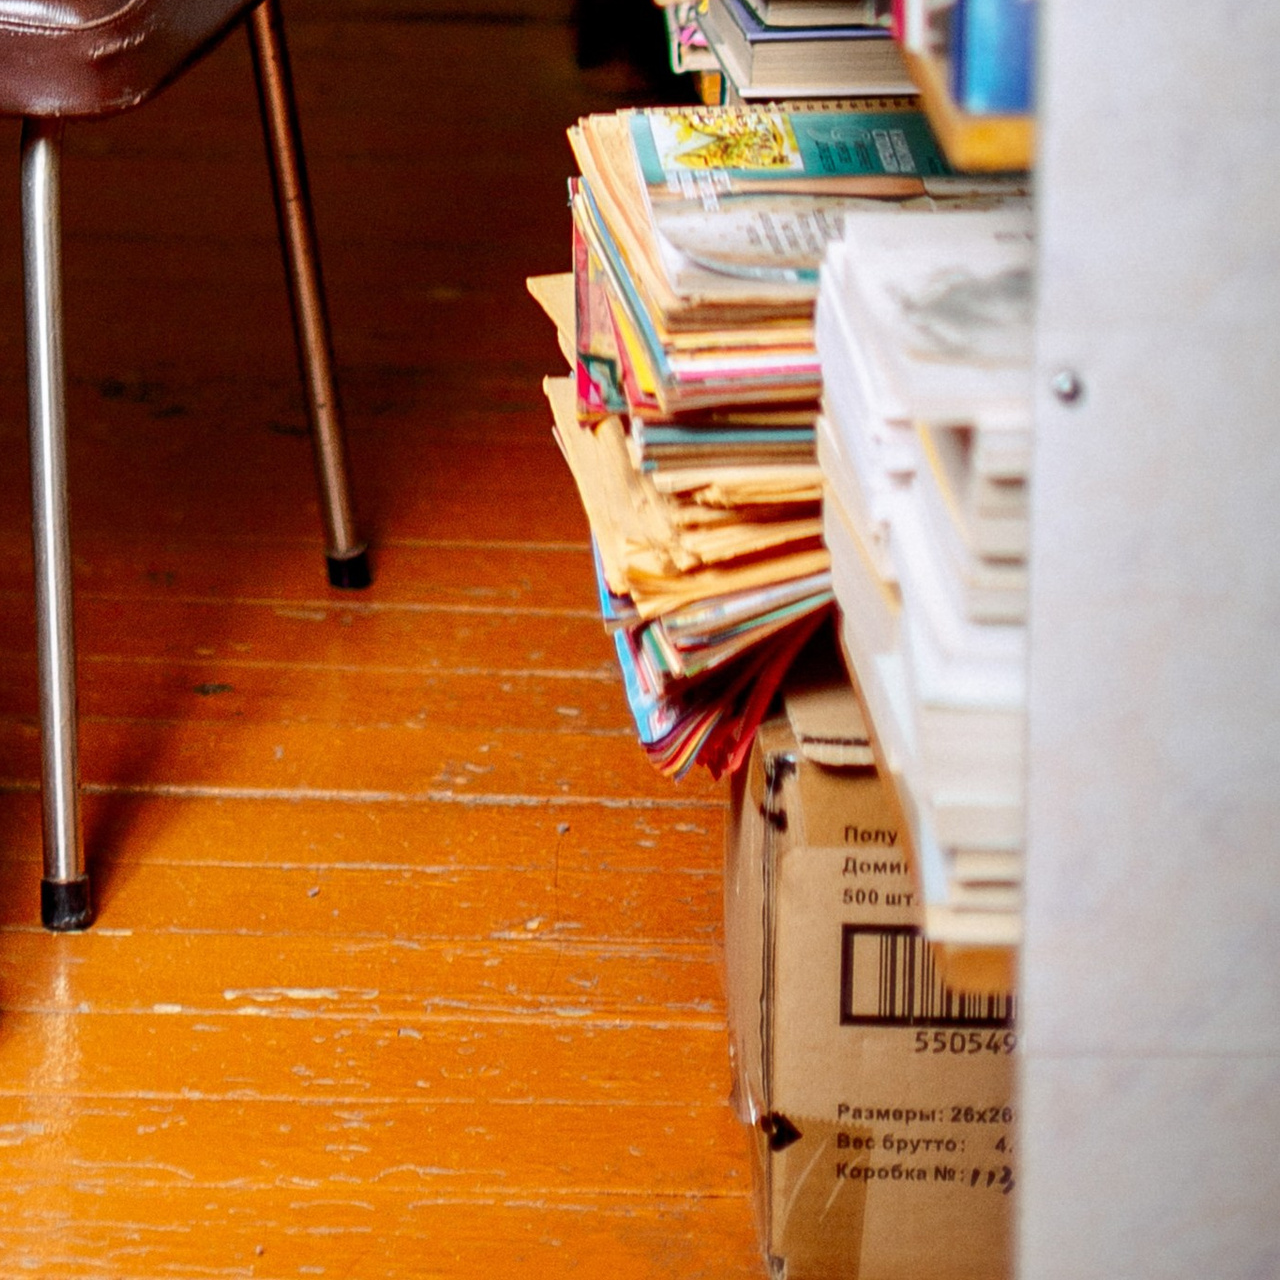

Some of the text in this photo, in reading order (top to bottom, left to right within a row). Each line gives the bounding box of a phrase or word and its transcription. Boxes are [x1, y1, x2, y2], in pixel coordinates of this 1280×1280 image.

[842, 887, 879, 906] 500
[915, 1031, 1017, 1055] 550549
[837, 1103, 944, 1126] Размеры:
[836, 1132, 876, 1150] Вес
[882, 1133, 966, 1155] брутто:
[836, 1163, 928, 1182] Коробка
